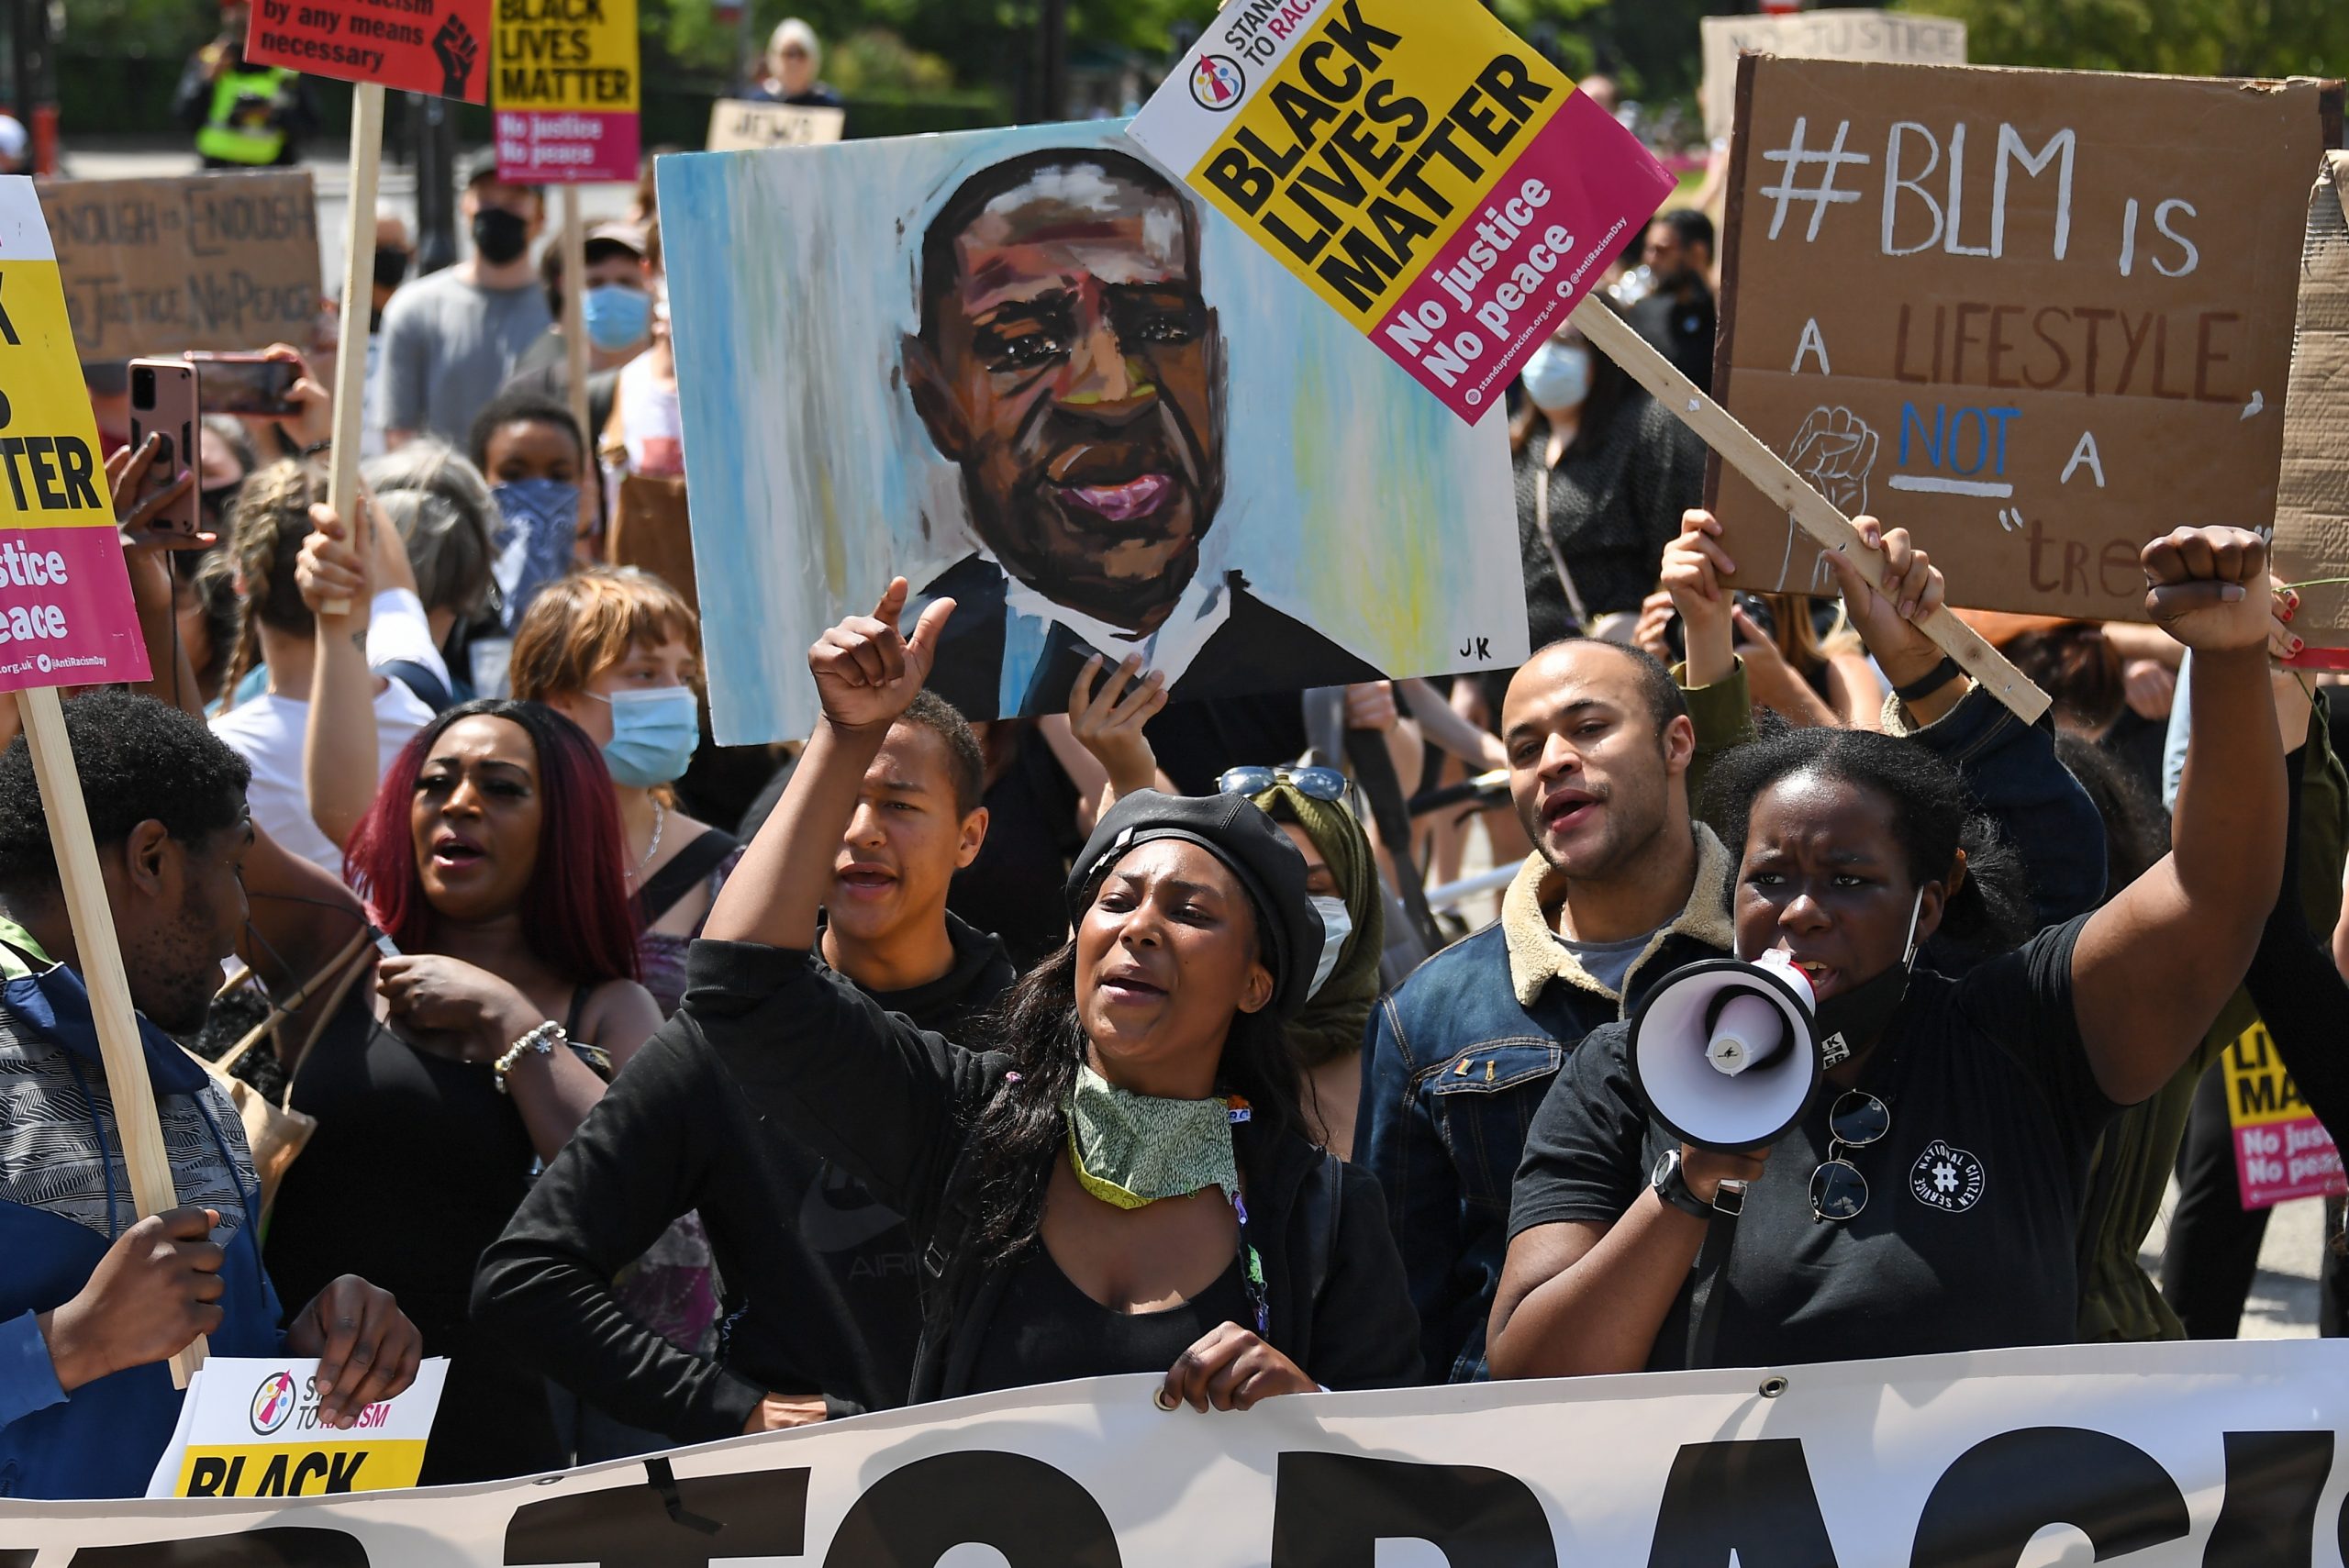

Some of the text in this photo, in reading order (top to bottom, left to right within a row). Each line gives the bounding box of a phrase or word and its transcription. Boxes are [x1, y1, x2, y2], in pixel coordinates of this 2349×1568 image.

[263, 0, 424, 46] by any means
[500, 0, 605, 25] BLACK
[1242, 0, 1319, 67] TO RAC
[261, 30, 384, 73] necessary
[500, 28, 592, 61] LIVES
[1803, 17, 1962, 57] JUSTICE
[501, 68, 630, 104] MATTER
[498, 112, 603, 146] No justice
[1203, 0, 1403, 217] BLACK
[499, 140, 595, 168] No peace
[1259, 79, 1429, 265] LIVES
[1315, 53, 1553, 313] MATTER
[1758, 117, 2199, 277] #BLM IS
[1385, 178, 1551, 358] No justice
[1421, 225, 1575, 388] No peace
[1478, 216, 1629, 392] standuptoracism.org.uk @AntiRacismDay
[1791, 317, 1831, 376] A
[1898, 401, 2105, 488] NOT A
[51, 655, 107, 670] @AntiRacismDay
[1918, 1144, 1964, 1170] NATIONAL
[2242, 1128, 2281, 1157] No
[1914, 1177, 1953, 1208] SERVICE
[1957, 1163, 1981, 1207] CITIZEN
[2245, 1157, 2284, 1185] No
